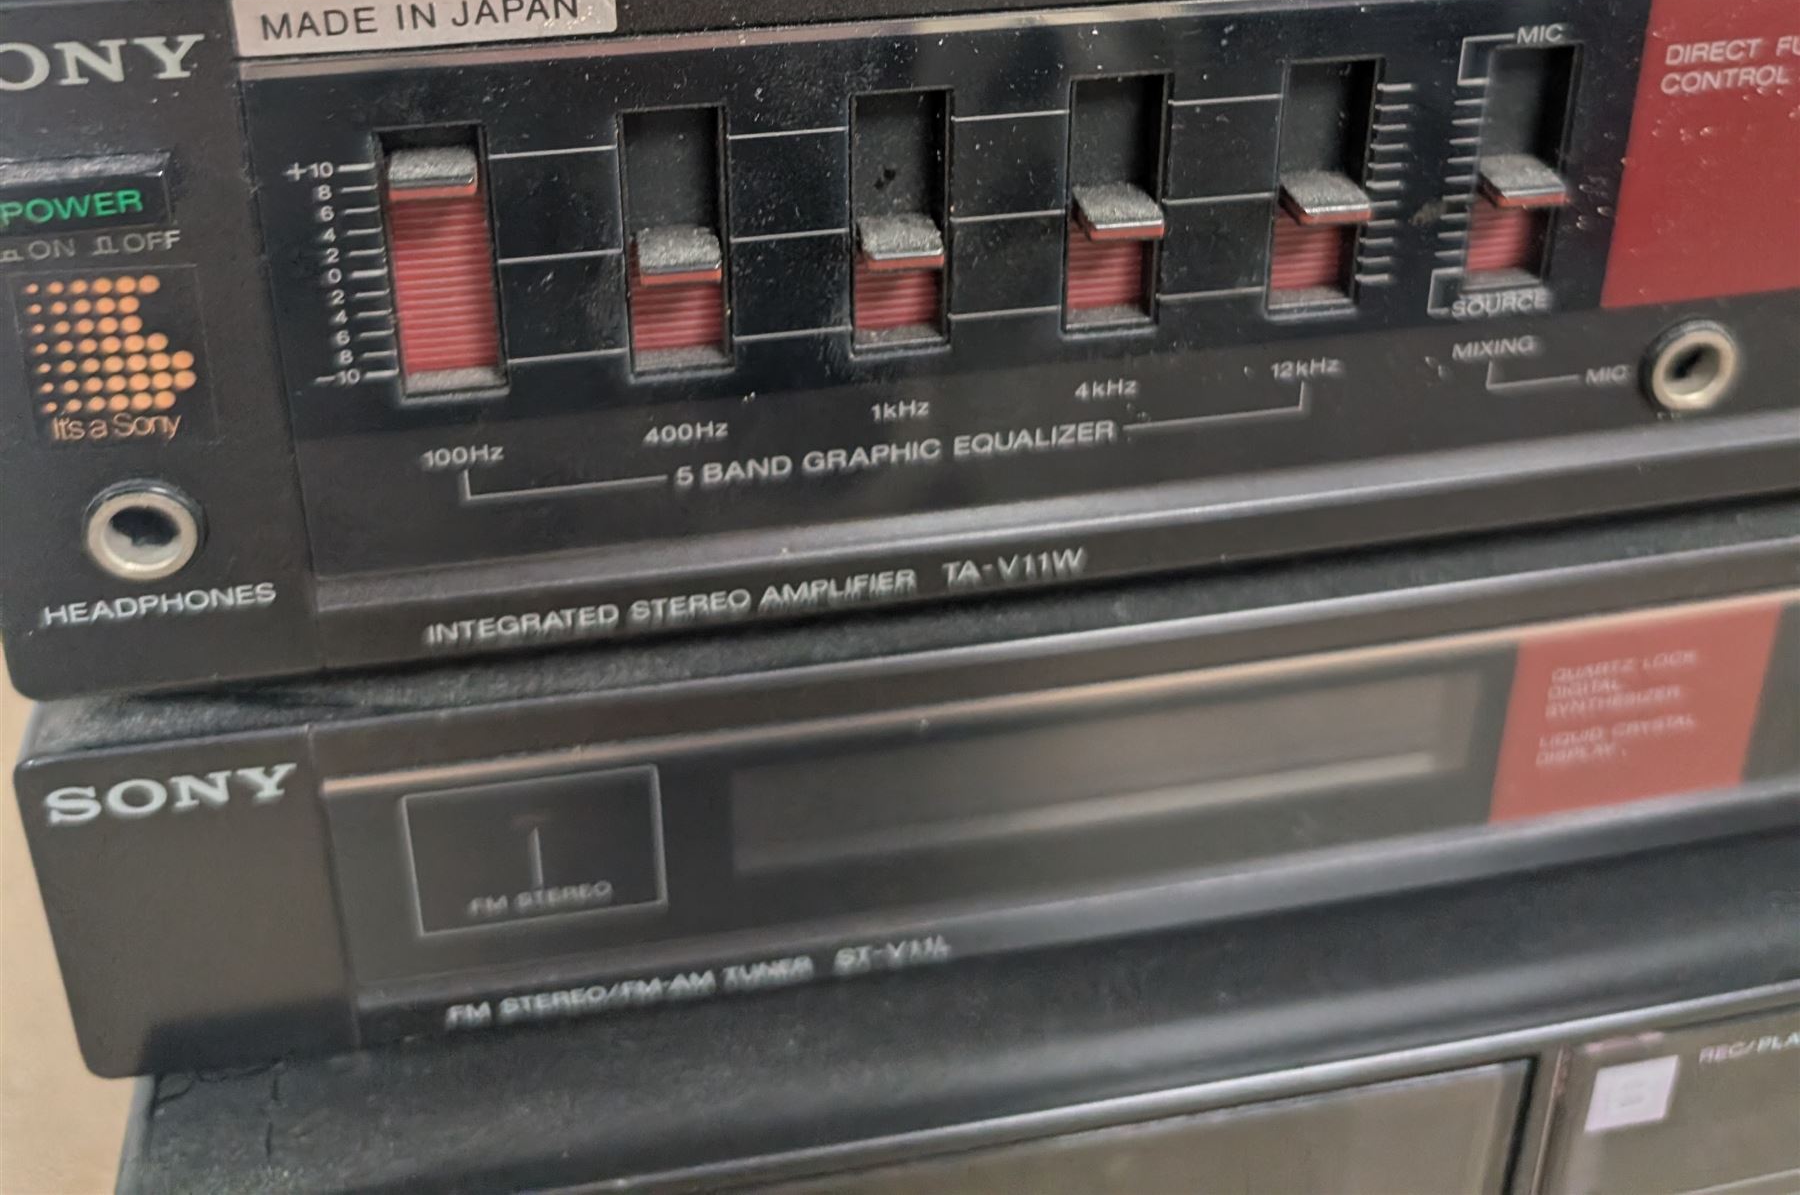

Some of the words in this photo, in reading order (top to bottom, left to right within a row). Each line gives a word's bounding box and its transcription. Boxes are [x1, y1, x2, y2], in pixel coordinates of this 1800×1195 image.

[260, 7, 378, 40] MADE
[396, 2, 437, 30] IN
[1517, 23, 1564, 45] MIC
[0, 33, 205, 91] ONY
[1665, 37, 1764, 66] DIRECT
[1660, 65, 1790, 95] CONTROL
[317, 184, 333, 201] 8
[0, 189, 144, 227] POWER
[319, 205, 335, 222] 6
[28, 238, 76, 261] ON
[123, 230, 181, 254] OFF
[322, 227, 337, 242] 4
[325, 247, 340, 264] 2
[327, 267, 342, 284] 0
[329, 289, 345, 306] 2
[1451, 288, 1552, 320] SOURCE
[333, 309, 348, 325] 4
[335, 330, 351, 347] 6
[1452, 335, 1537, 361] MIXING
[339, 349, 354, 365] 8
[1270, 357, 1344, 381] 12kHz
[1585, 364, 1632, 387] MIC
[1074, 378, 1138, 402] 4kHz
[871, 399, 930, 423] 1kHz
[88, 419, 109, 440] a
[112, 413, 182, 441] Sony
[643, 421, 729, 447] 400Hz
[421, 444, 505, 471] 100Hz
[675, 465, 695, 487] 5
[702, 454, 793, 485] BAND
[802, 436, 941, 473] GRAPHIC
[952, 419, 1117, 455] EQUALIZER
[42, 581, 277, 627] HEADPHONES
[427, 603, 620, 644] INTEGRATED
[630, 588, 751, 625] STEREO
[757, 568, 917, 608] AMPLIFIER
[943, 547, 1084, 586] TA-V11W
[44, 762, 297, 826] SONY
[468, 896, 509, 918] FM
[513, 881, 613, 911] STEREO
[445, 1003, 492, 1031] FM
[724, 956, 813, 991] TUNER
